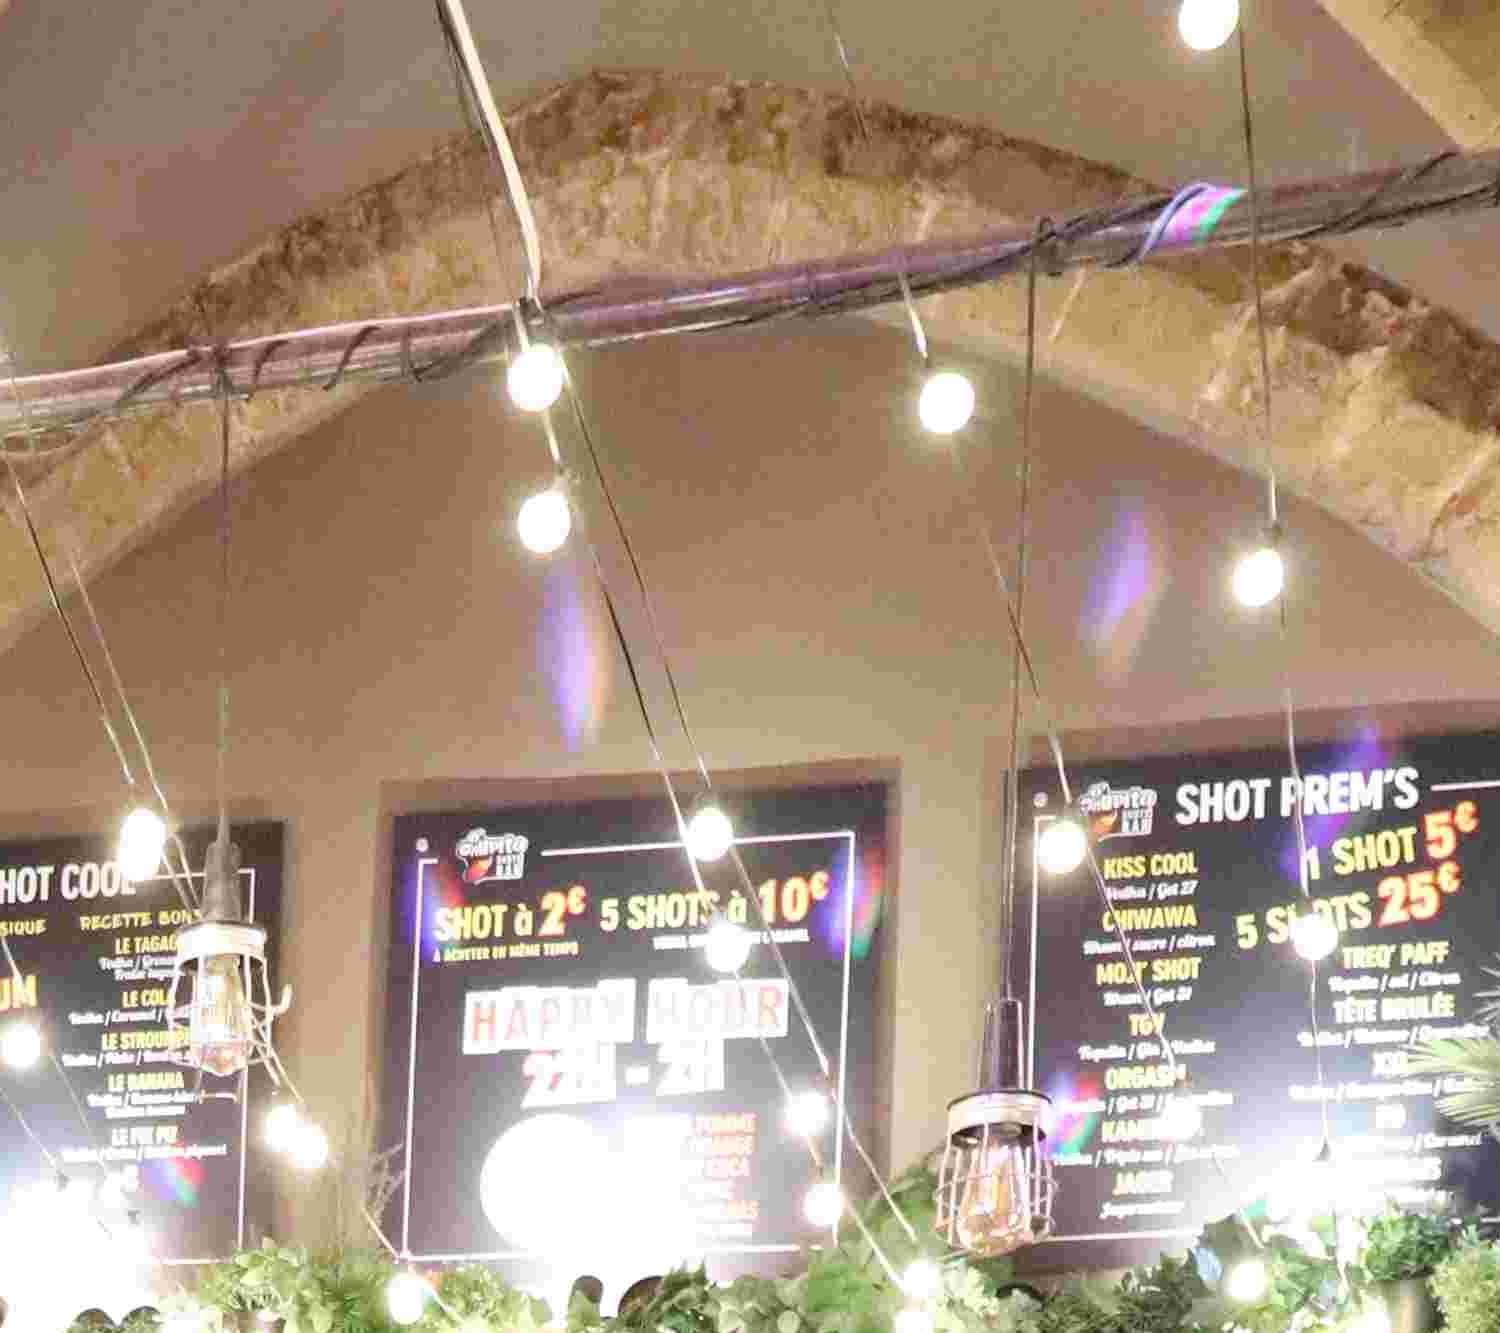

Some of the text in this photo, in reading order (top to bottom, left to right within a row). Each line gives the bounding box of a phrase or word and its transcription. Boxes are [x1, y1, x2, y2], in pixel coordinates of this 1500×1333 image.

[1176, 766, 1419, 826] SHOT PREM'S
[1332, 827, 1417, 875] SHOT
[1424, 800, 1479, 859] 5€
[1104, 852, 1199, 880] KISS COOL
[433, 885, 587, 941] SHOT à 2€
[600, 871, 829, 931] 5 SHOTS à 10€
[1236, 861, 1461, 950] 5 STS 25€
[79, 911, 153, 931] RECETTE
[1102, 904, 1197, 932] CHIWAWA
[115, 937, 130, 955] LE
[1400, 941, 1449, 966] PAFF
[1152, 957, 1202, 982] SHOT
[122, 990, 138, 1009] LE
[101, 1032, 118, 1051] LE
